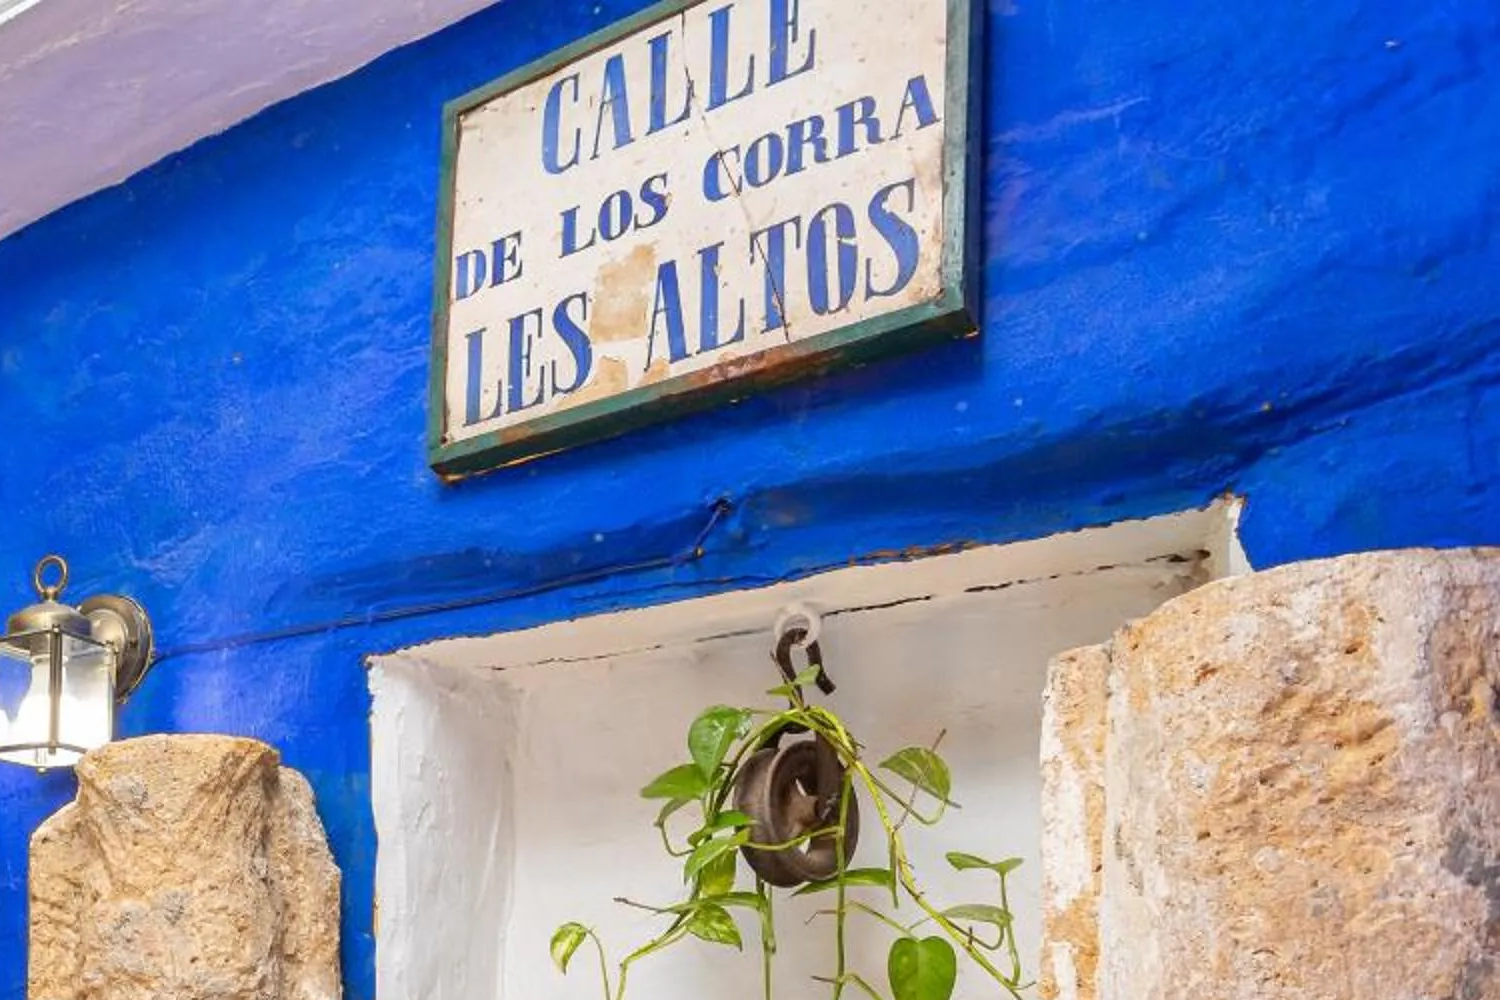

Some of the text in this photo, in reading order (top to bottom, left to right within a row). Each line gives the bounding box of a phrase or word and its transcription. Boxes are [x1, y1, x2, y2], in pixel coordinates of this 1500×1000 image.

[455, 75, 941, 301] DE LOS CORRA
[541, 0, 816, 175] CALLE
[462, 178, 921, 427] LES ALTOS
